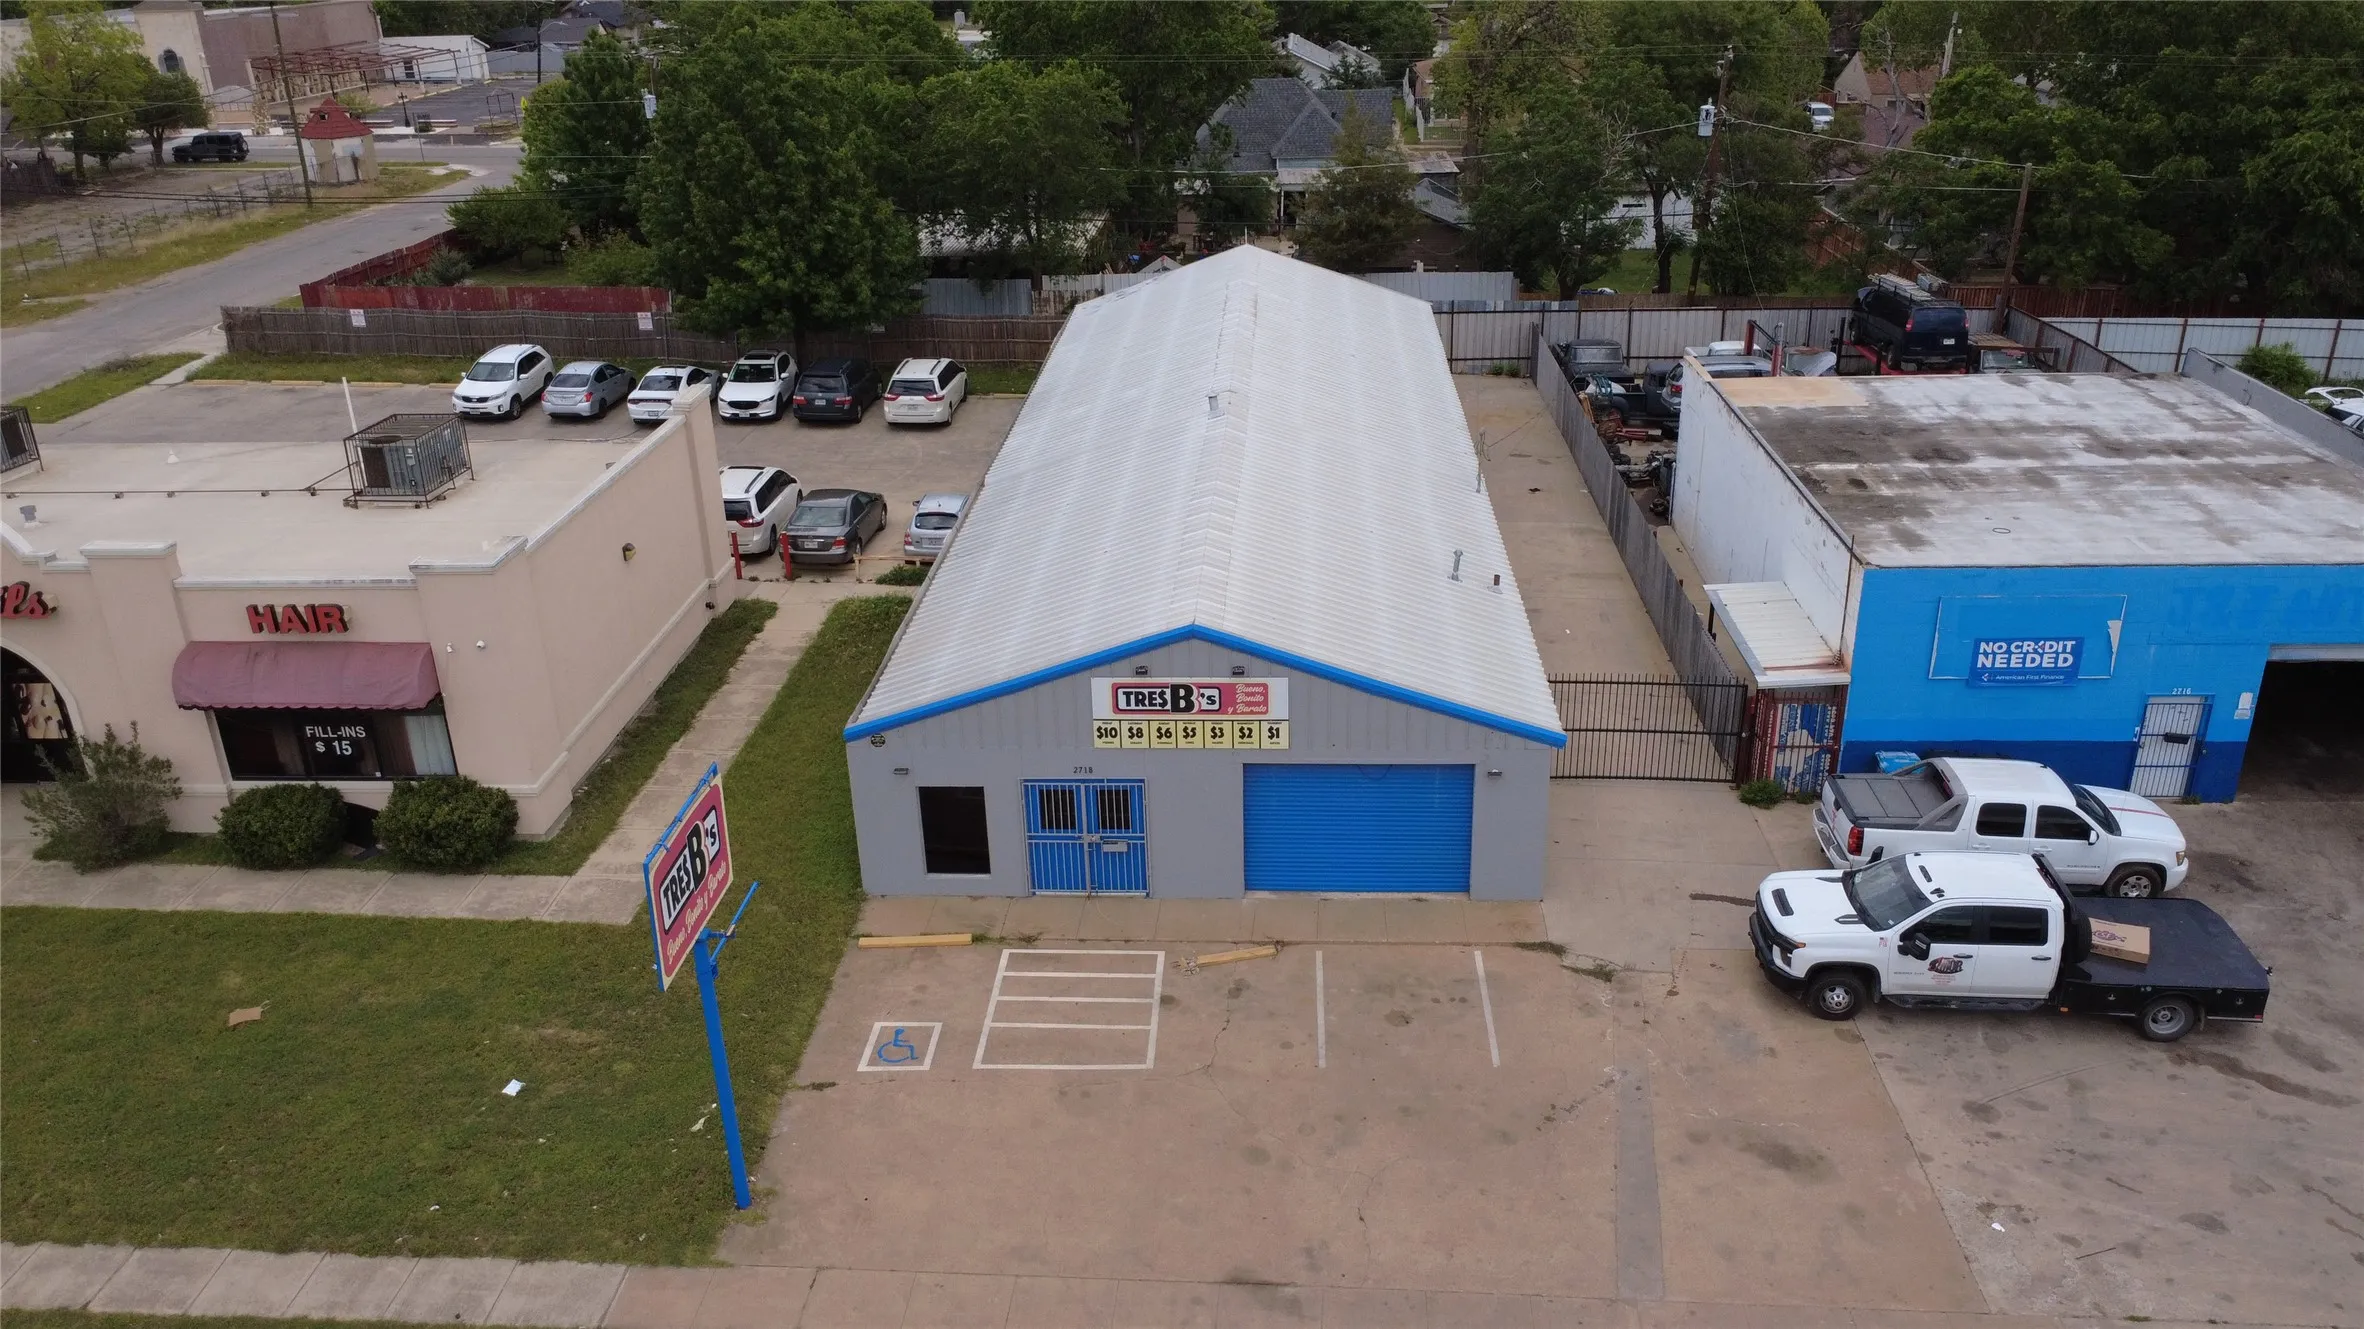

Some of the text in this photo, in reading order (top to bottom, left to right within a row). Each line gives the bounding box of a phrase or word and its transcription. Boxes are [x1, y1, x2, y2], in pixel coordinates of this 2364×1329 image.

[246, 603, 350, 634] HAIR
[1979, 641, 2008, 653] NO
[1977, 653, 2074, 668] NEEDED
[2172, 687, 2192, 695] 2716
[1236, 694, 1264, 703] Bonito
[1227, 704, 1267, 715] y Barato
[305, 726, 366, 738] FILL-INS
[1096, 726, 1118, 739] $10
[1128, 726, 1144, 739] $8
[1156, 726, 1173, 739] $6
[1182, 726, 1197, 739] $5
[1210, 726, 1225, 739] $3
[1238, 726, 1253, 739] $2
[1267, 726, 1280, 740] $1
[315, 740, 353, 756] $ 15
[1073, 766, 1093, 774] 2718
[685, 896, 704, 934] Bonito
